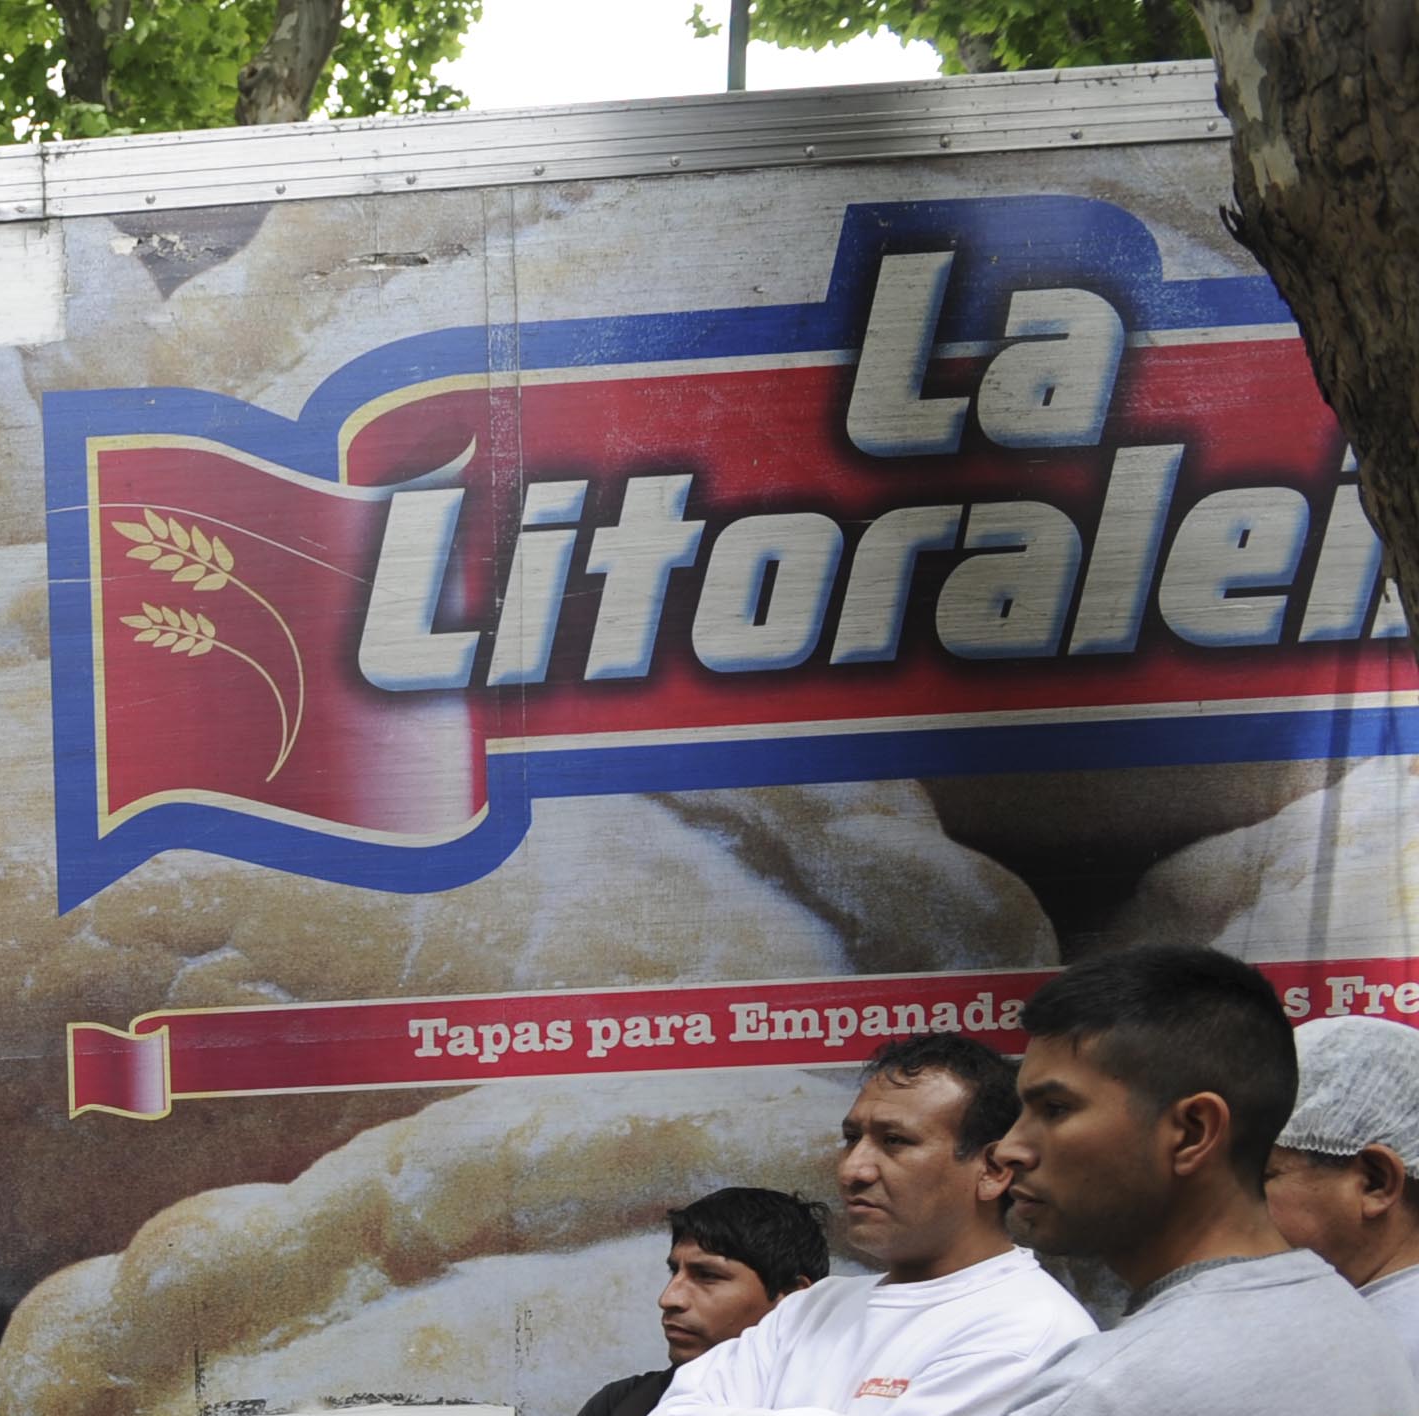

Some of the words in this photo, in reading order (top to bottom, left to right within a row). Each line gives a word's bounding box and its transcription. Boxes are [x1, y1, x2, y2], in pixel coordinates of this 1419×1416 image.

[846, 250, 1127, 458] La
[408, 1016, 574, 1064] Tapas
[586, 1009, 716, 1059] para
[728, 992, 1026, 1047] Empanada
[1325, 975, 1419, 1016] Fre
